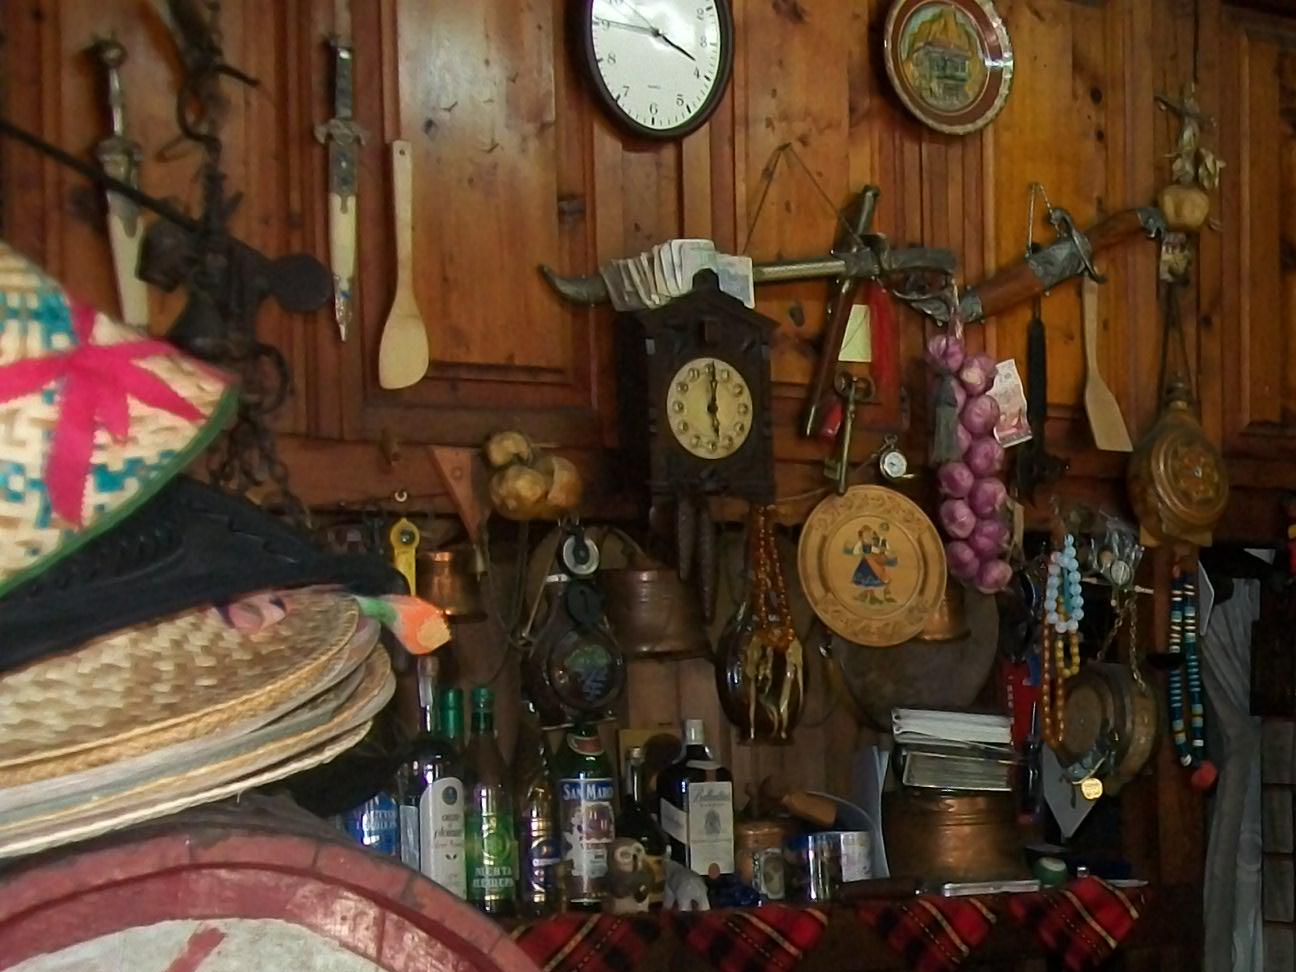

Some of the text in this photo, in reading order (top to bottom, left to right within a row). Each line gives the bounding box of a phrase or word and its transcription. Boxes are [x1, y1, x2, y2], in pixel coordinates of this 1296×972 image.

[607, 53, 616, 64] 8
[693, 67, 700, 79] 4
[622, 85, 631, 97] 7
[676, 93, 685, 107] 5
[649, 103, 659, 115] 6
